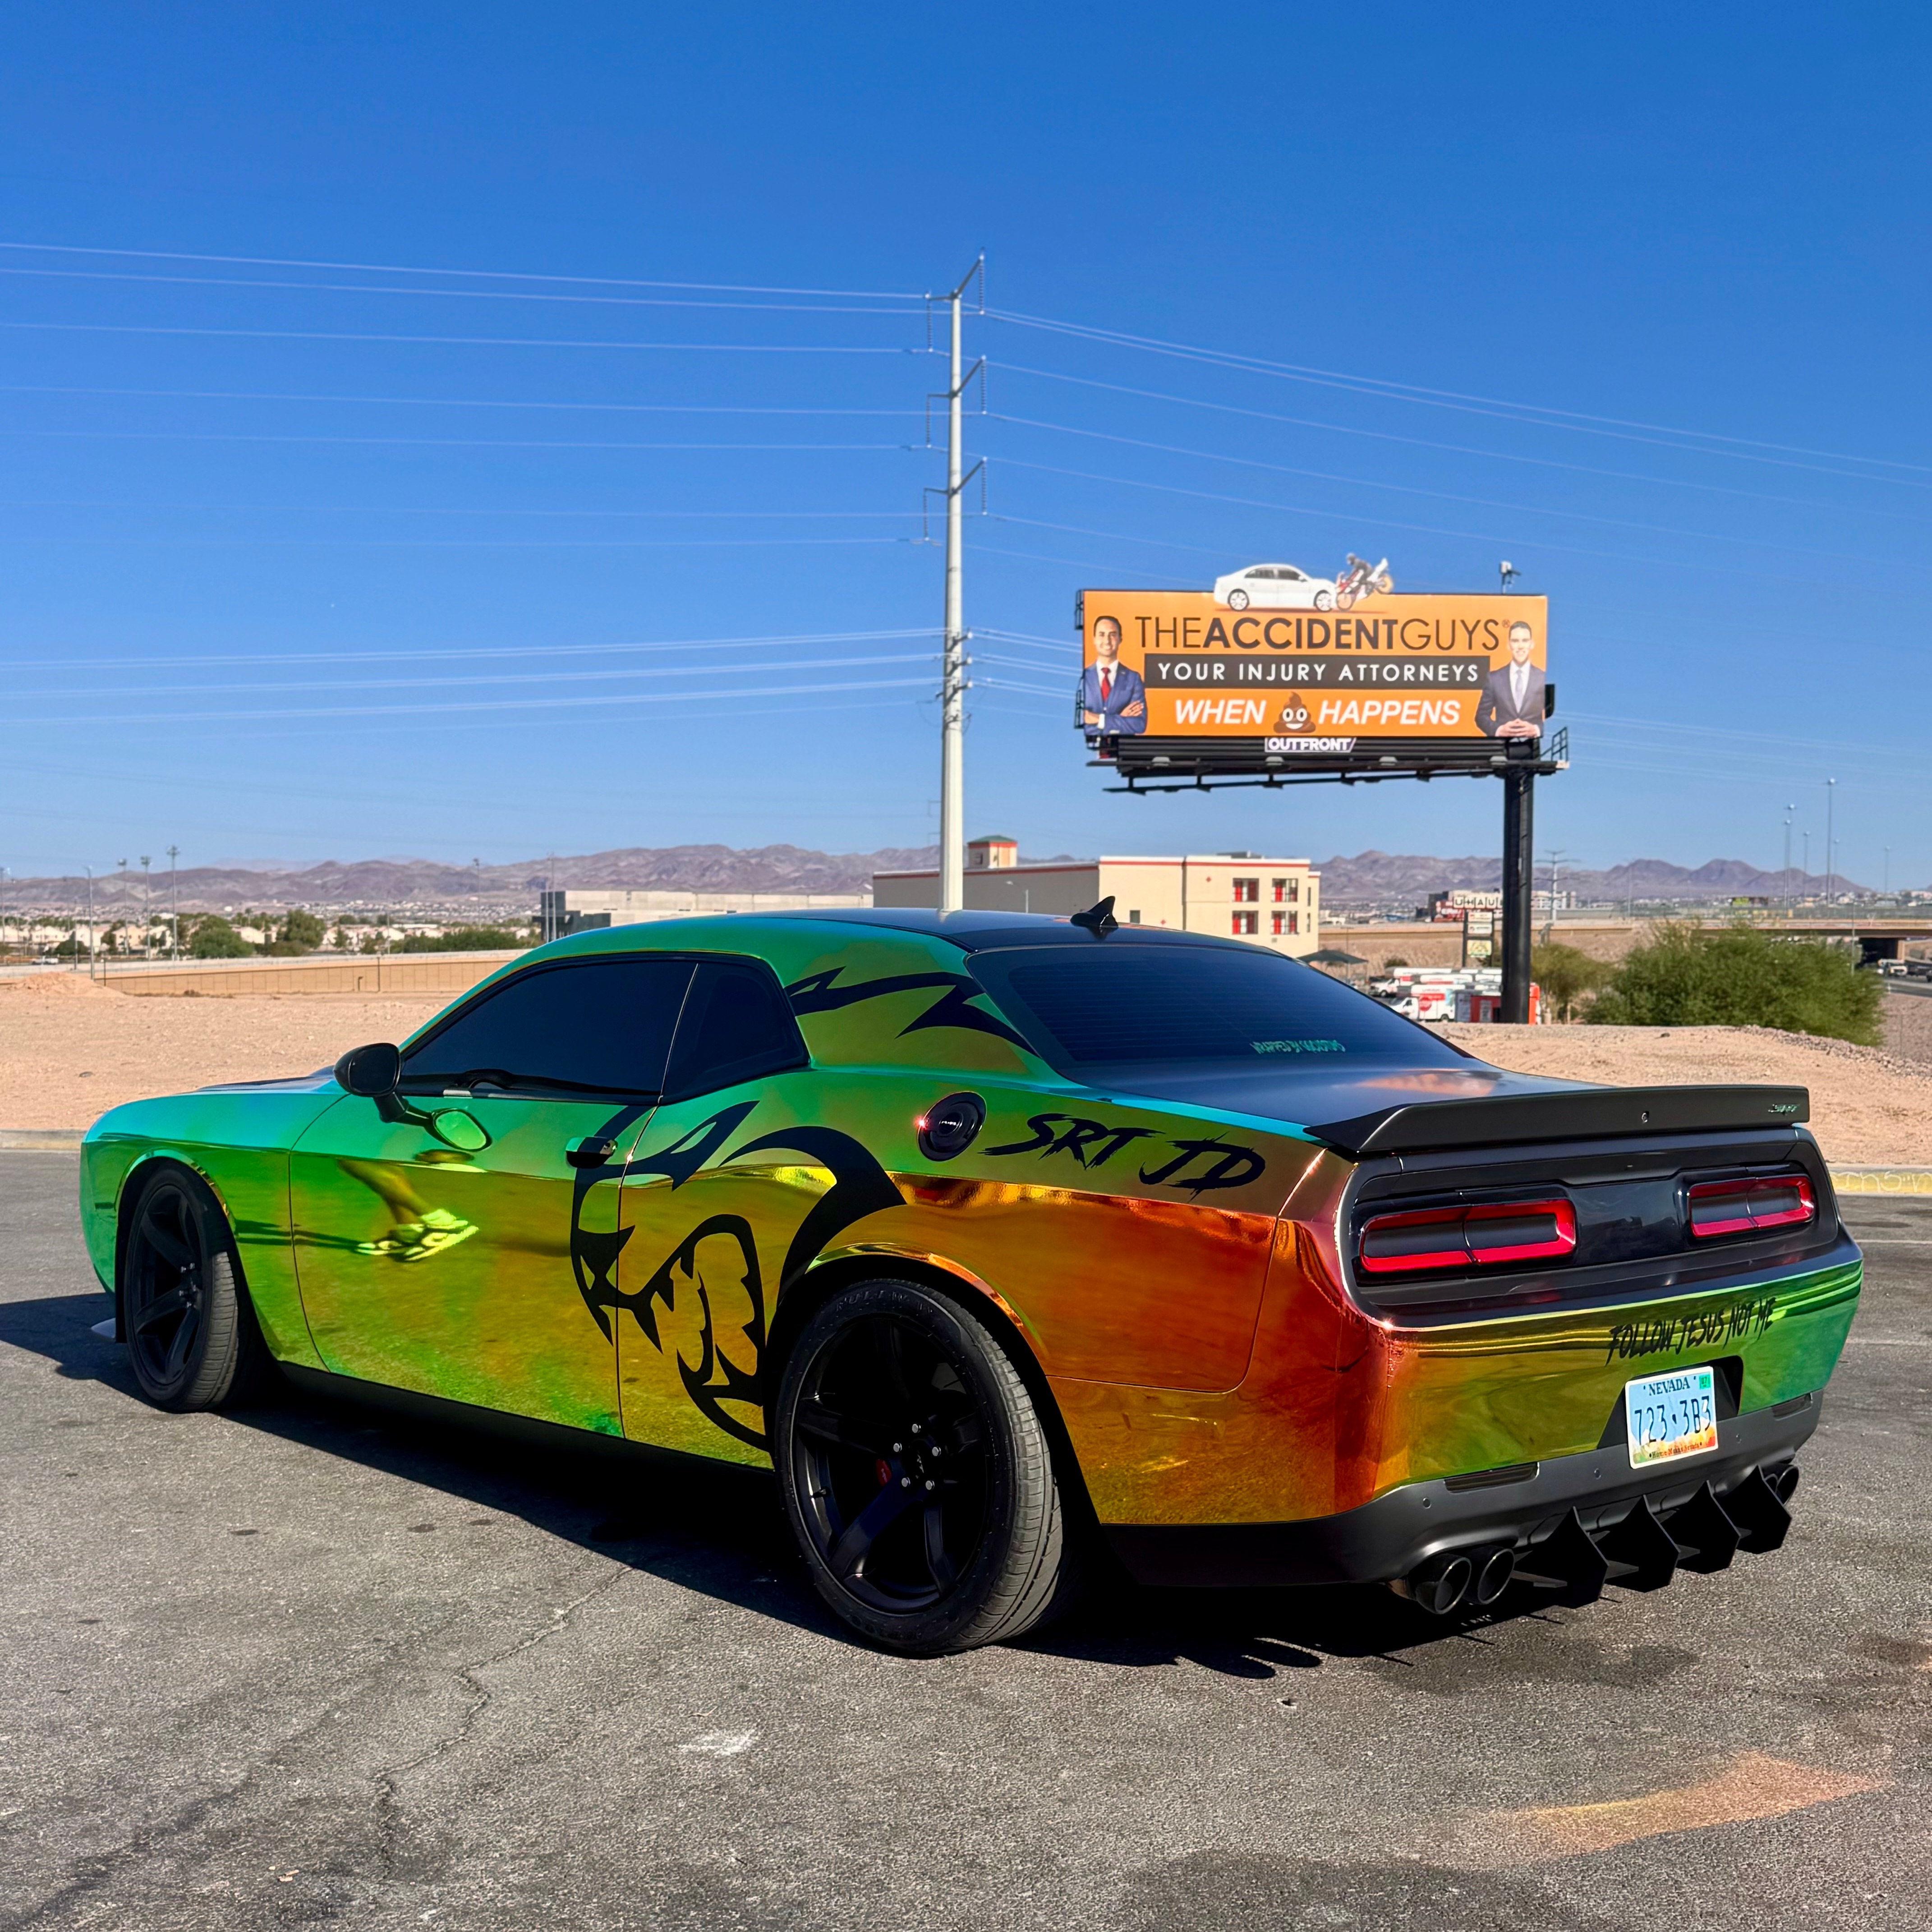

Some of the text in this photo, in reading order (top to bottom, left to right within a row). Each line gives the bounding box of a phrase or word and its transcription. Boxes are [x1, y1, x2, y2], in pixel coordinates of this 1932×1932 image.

[1158, 663, 1478, 682] YOUR INJURY ATTORNEYS
[1174, 699, 1461, 725] WHEN HAPPENS
[1268, 738, 1351, 751] OUTFRONT
[978, 1113, 1266, 1204] SRT JD
[1605, 1297, 1776, 1366] FOLLOW JESUS NOT ME
[1649, 1377, 1690, 1396] NEVADA
